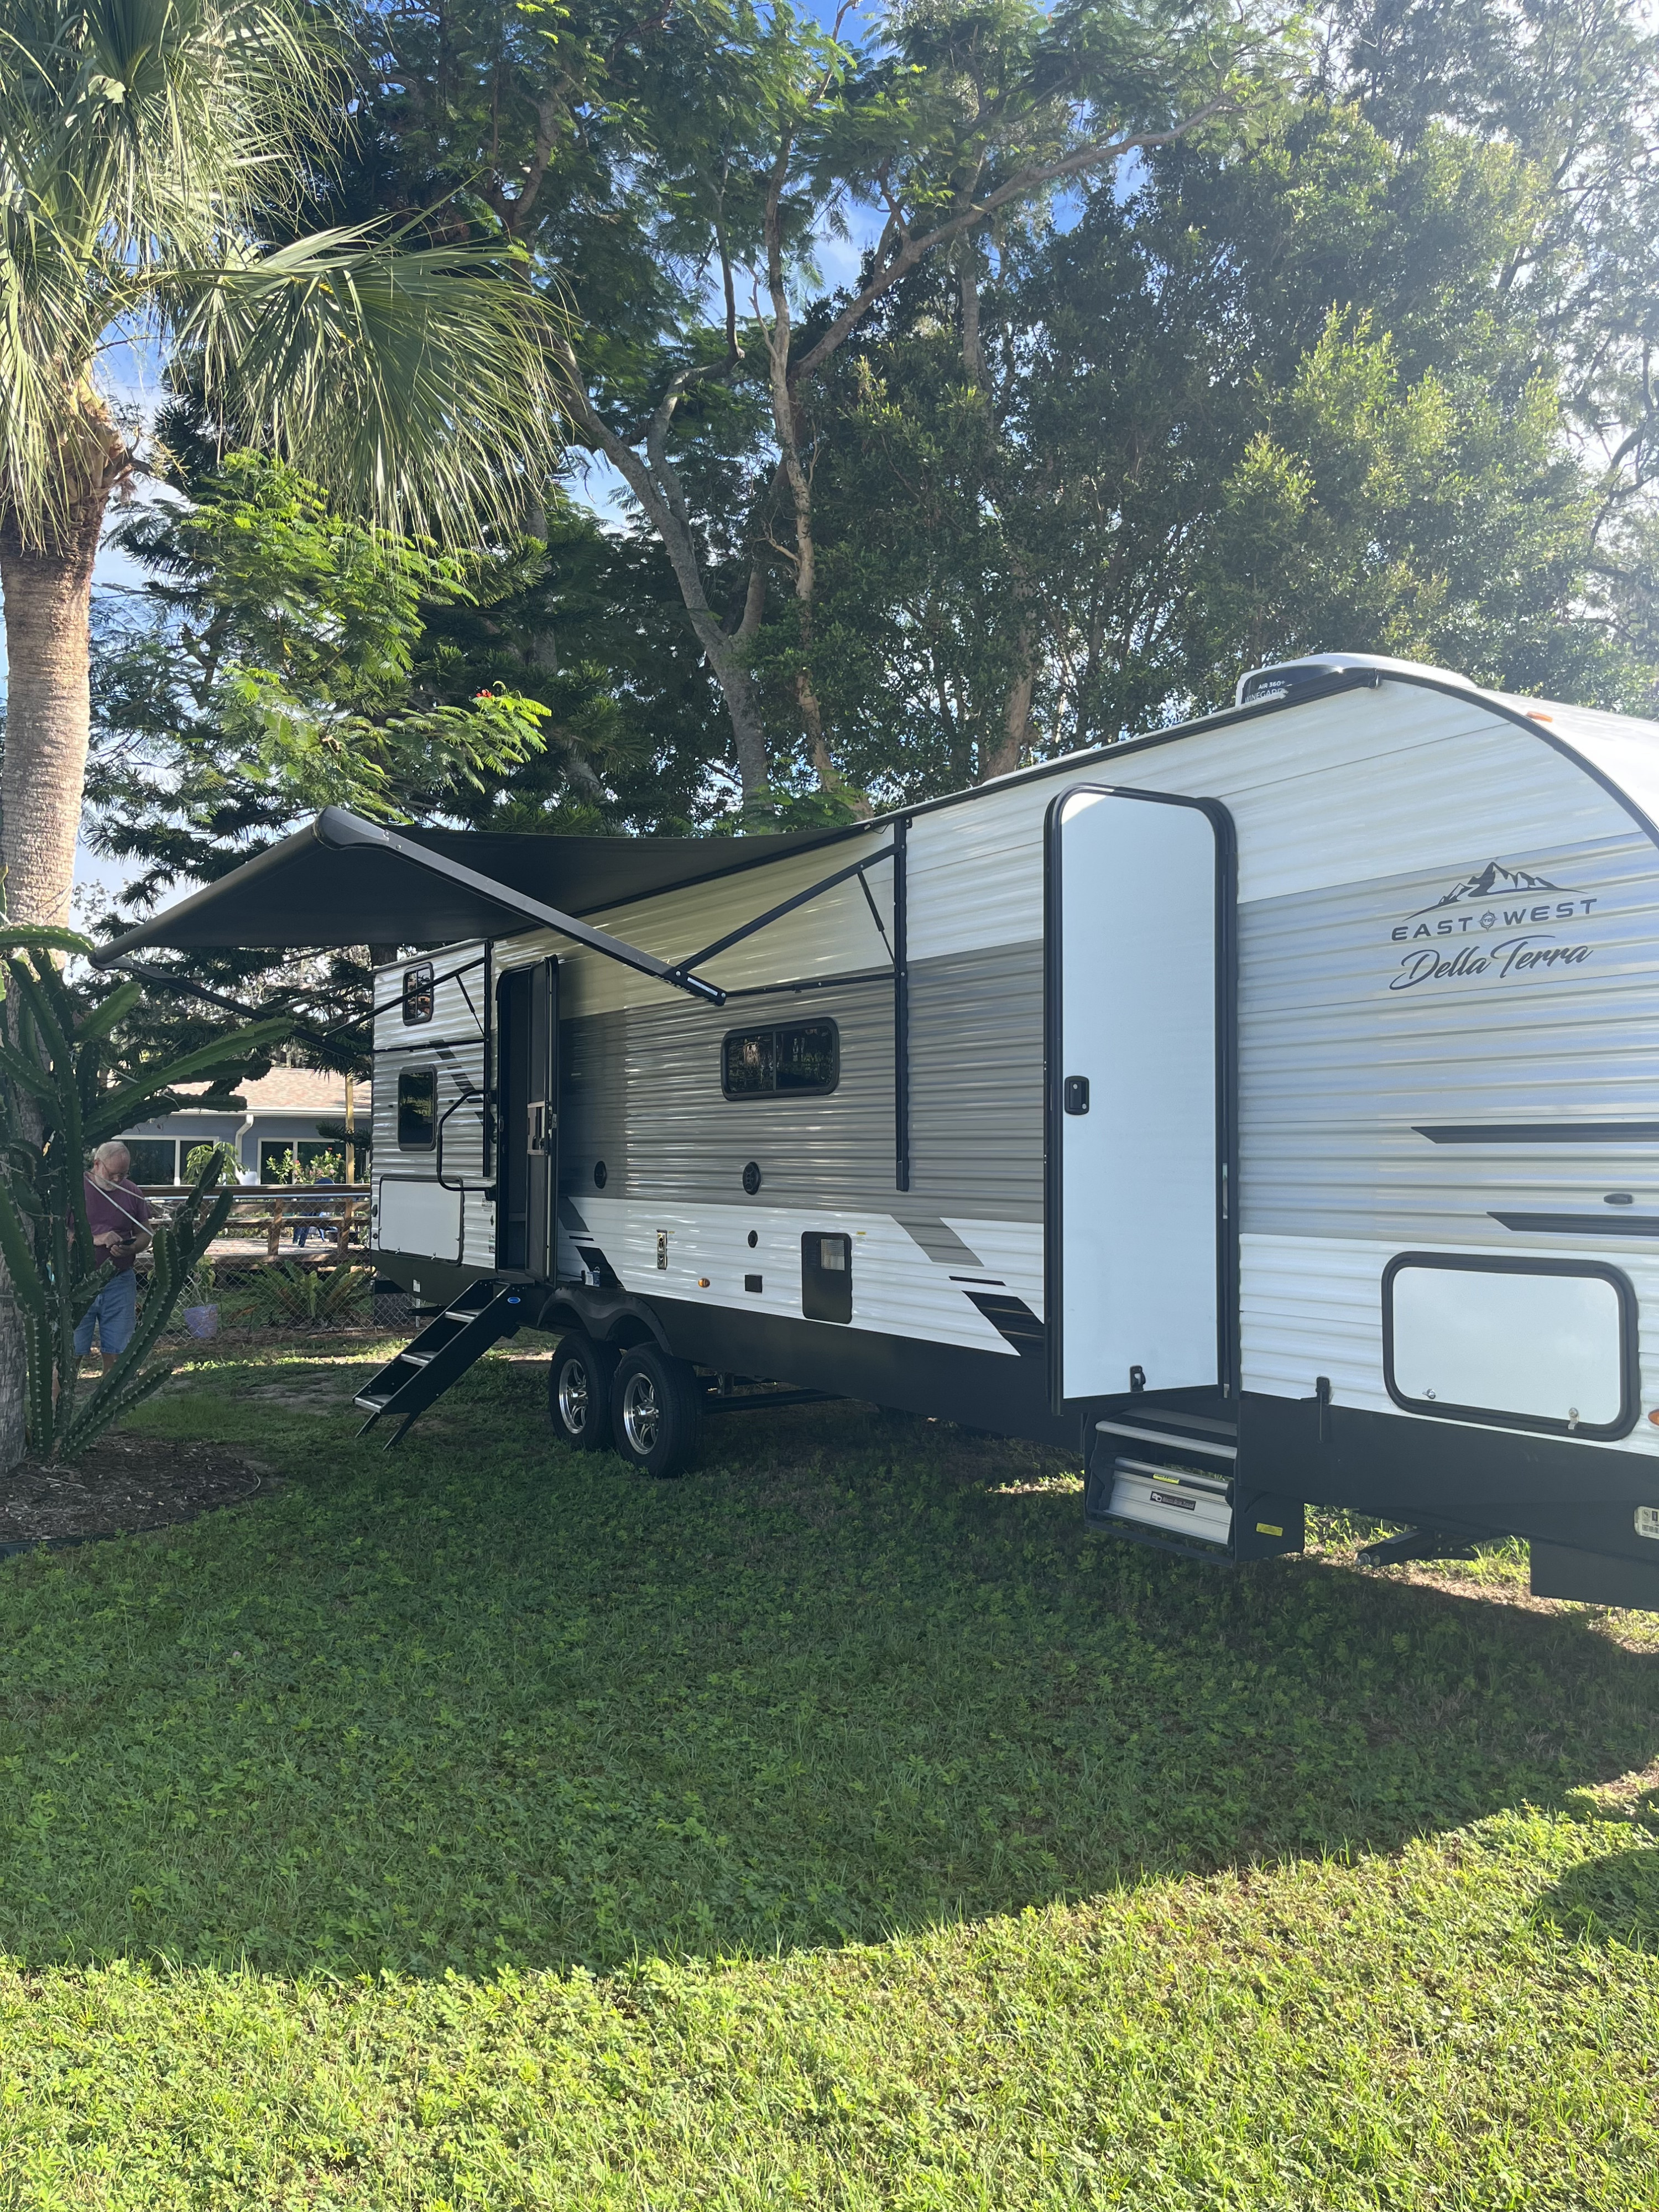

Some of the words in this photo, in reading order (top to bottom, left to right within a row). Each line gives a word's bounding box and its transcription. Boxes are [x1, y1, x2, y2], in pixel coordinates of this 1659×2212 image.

[1391, 917, 1473, 941] EAST
[1503, 899, 1597, 926] WEST
[1389, 946, 1491, 990] Della
[1490, 935, 1593, 978] Terra
